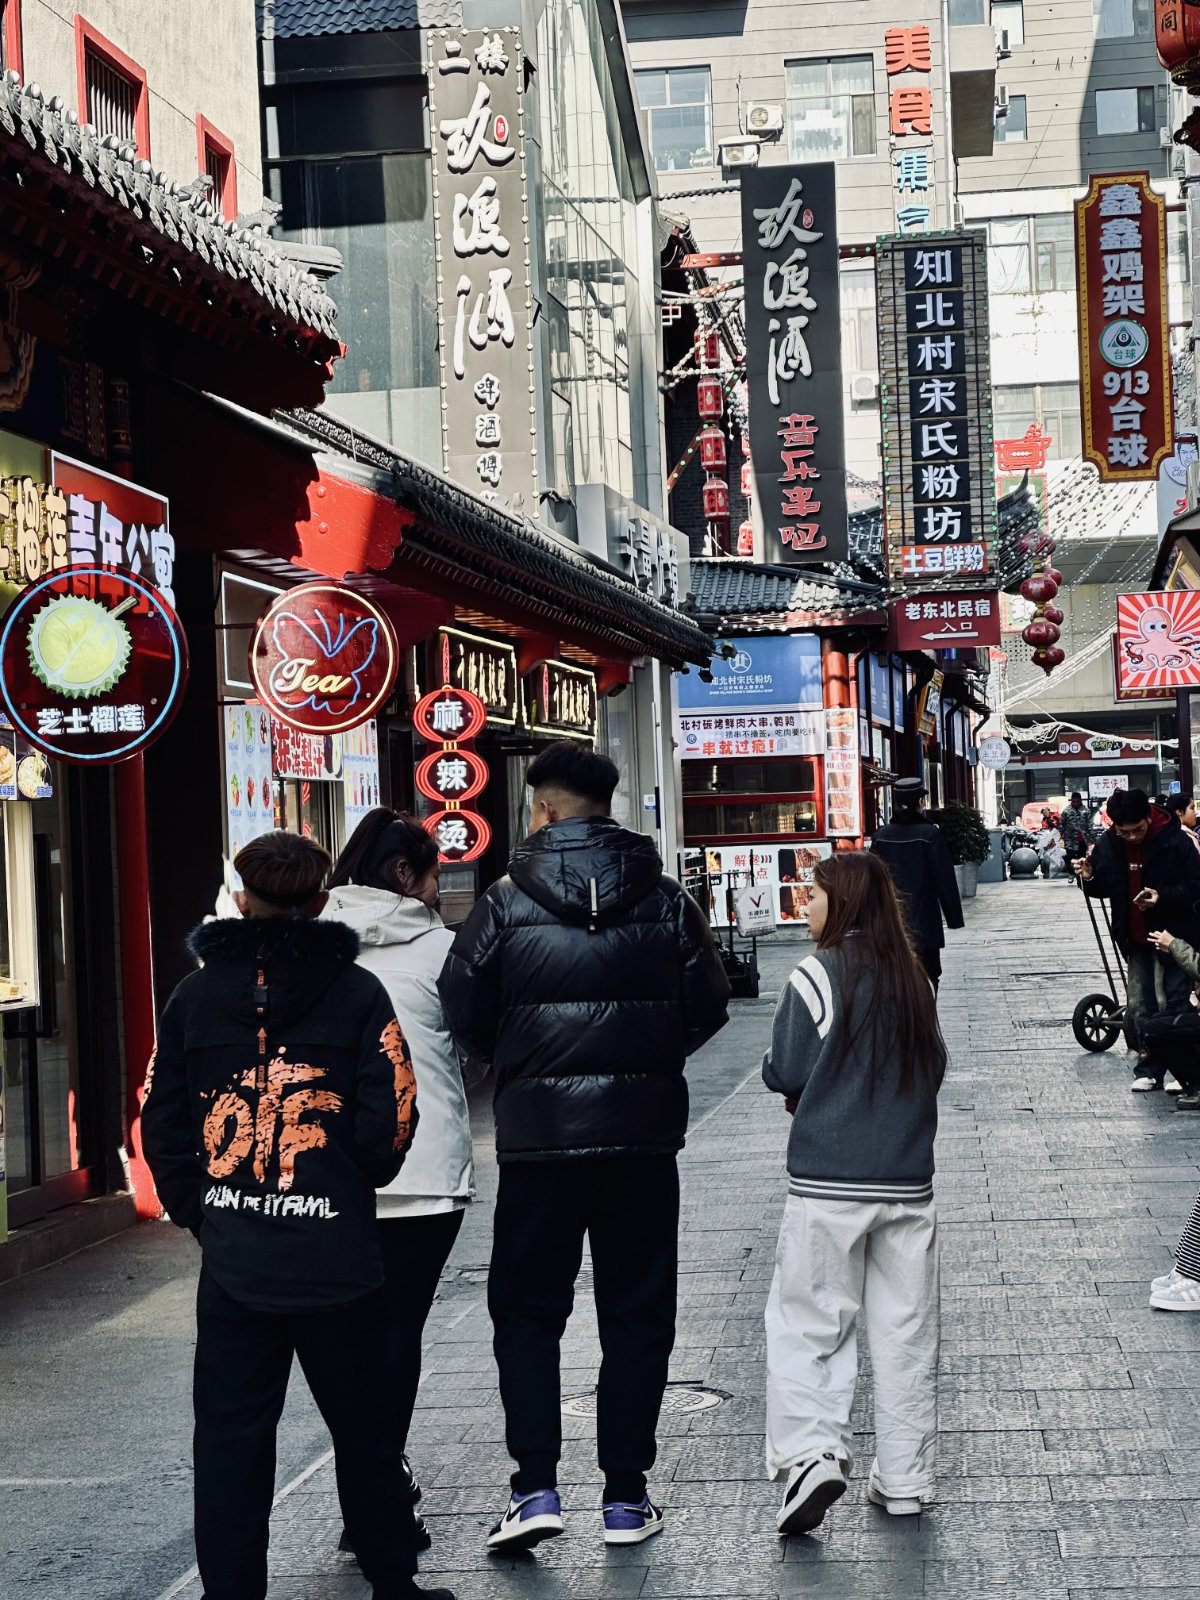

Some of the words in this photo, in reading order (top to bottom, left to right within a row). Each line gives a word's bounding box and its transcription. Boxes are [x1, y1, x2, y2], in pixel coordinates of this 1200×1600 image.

[1099, 184, 1146, 317] 鑫鑫鸡架
[1113, 348, 1137, 361] 台球
[914, 249, 963, 542] 知北村宋氏粉坊
[776, 413, 827, 551] 音乐串吧
[902, 544, 985, 574] 土豆鲜粉
[905, 599, 991, 621] 老东北民宿
[941, 621, 973, 633] 入口
[275, 658, 351, 693] Tea
[36, 704, 146, 735] 芝士榴莲
[433, 700, 469, 851] 麻辣烫
